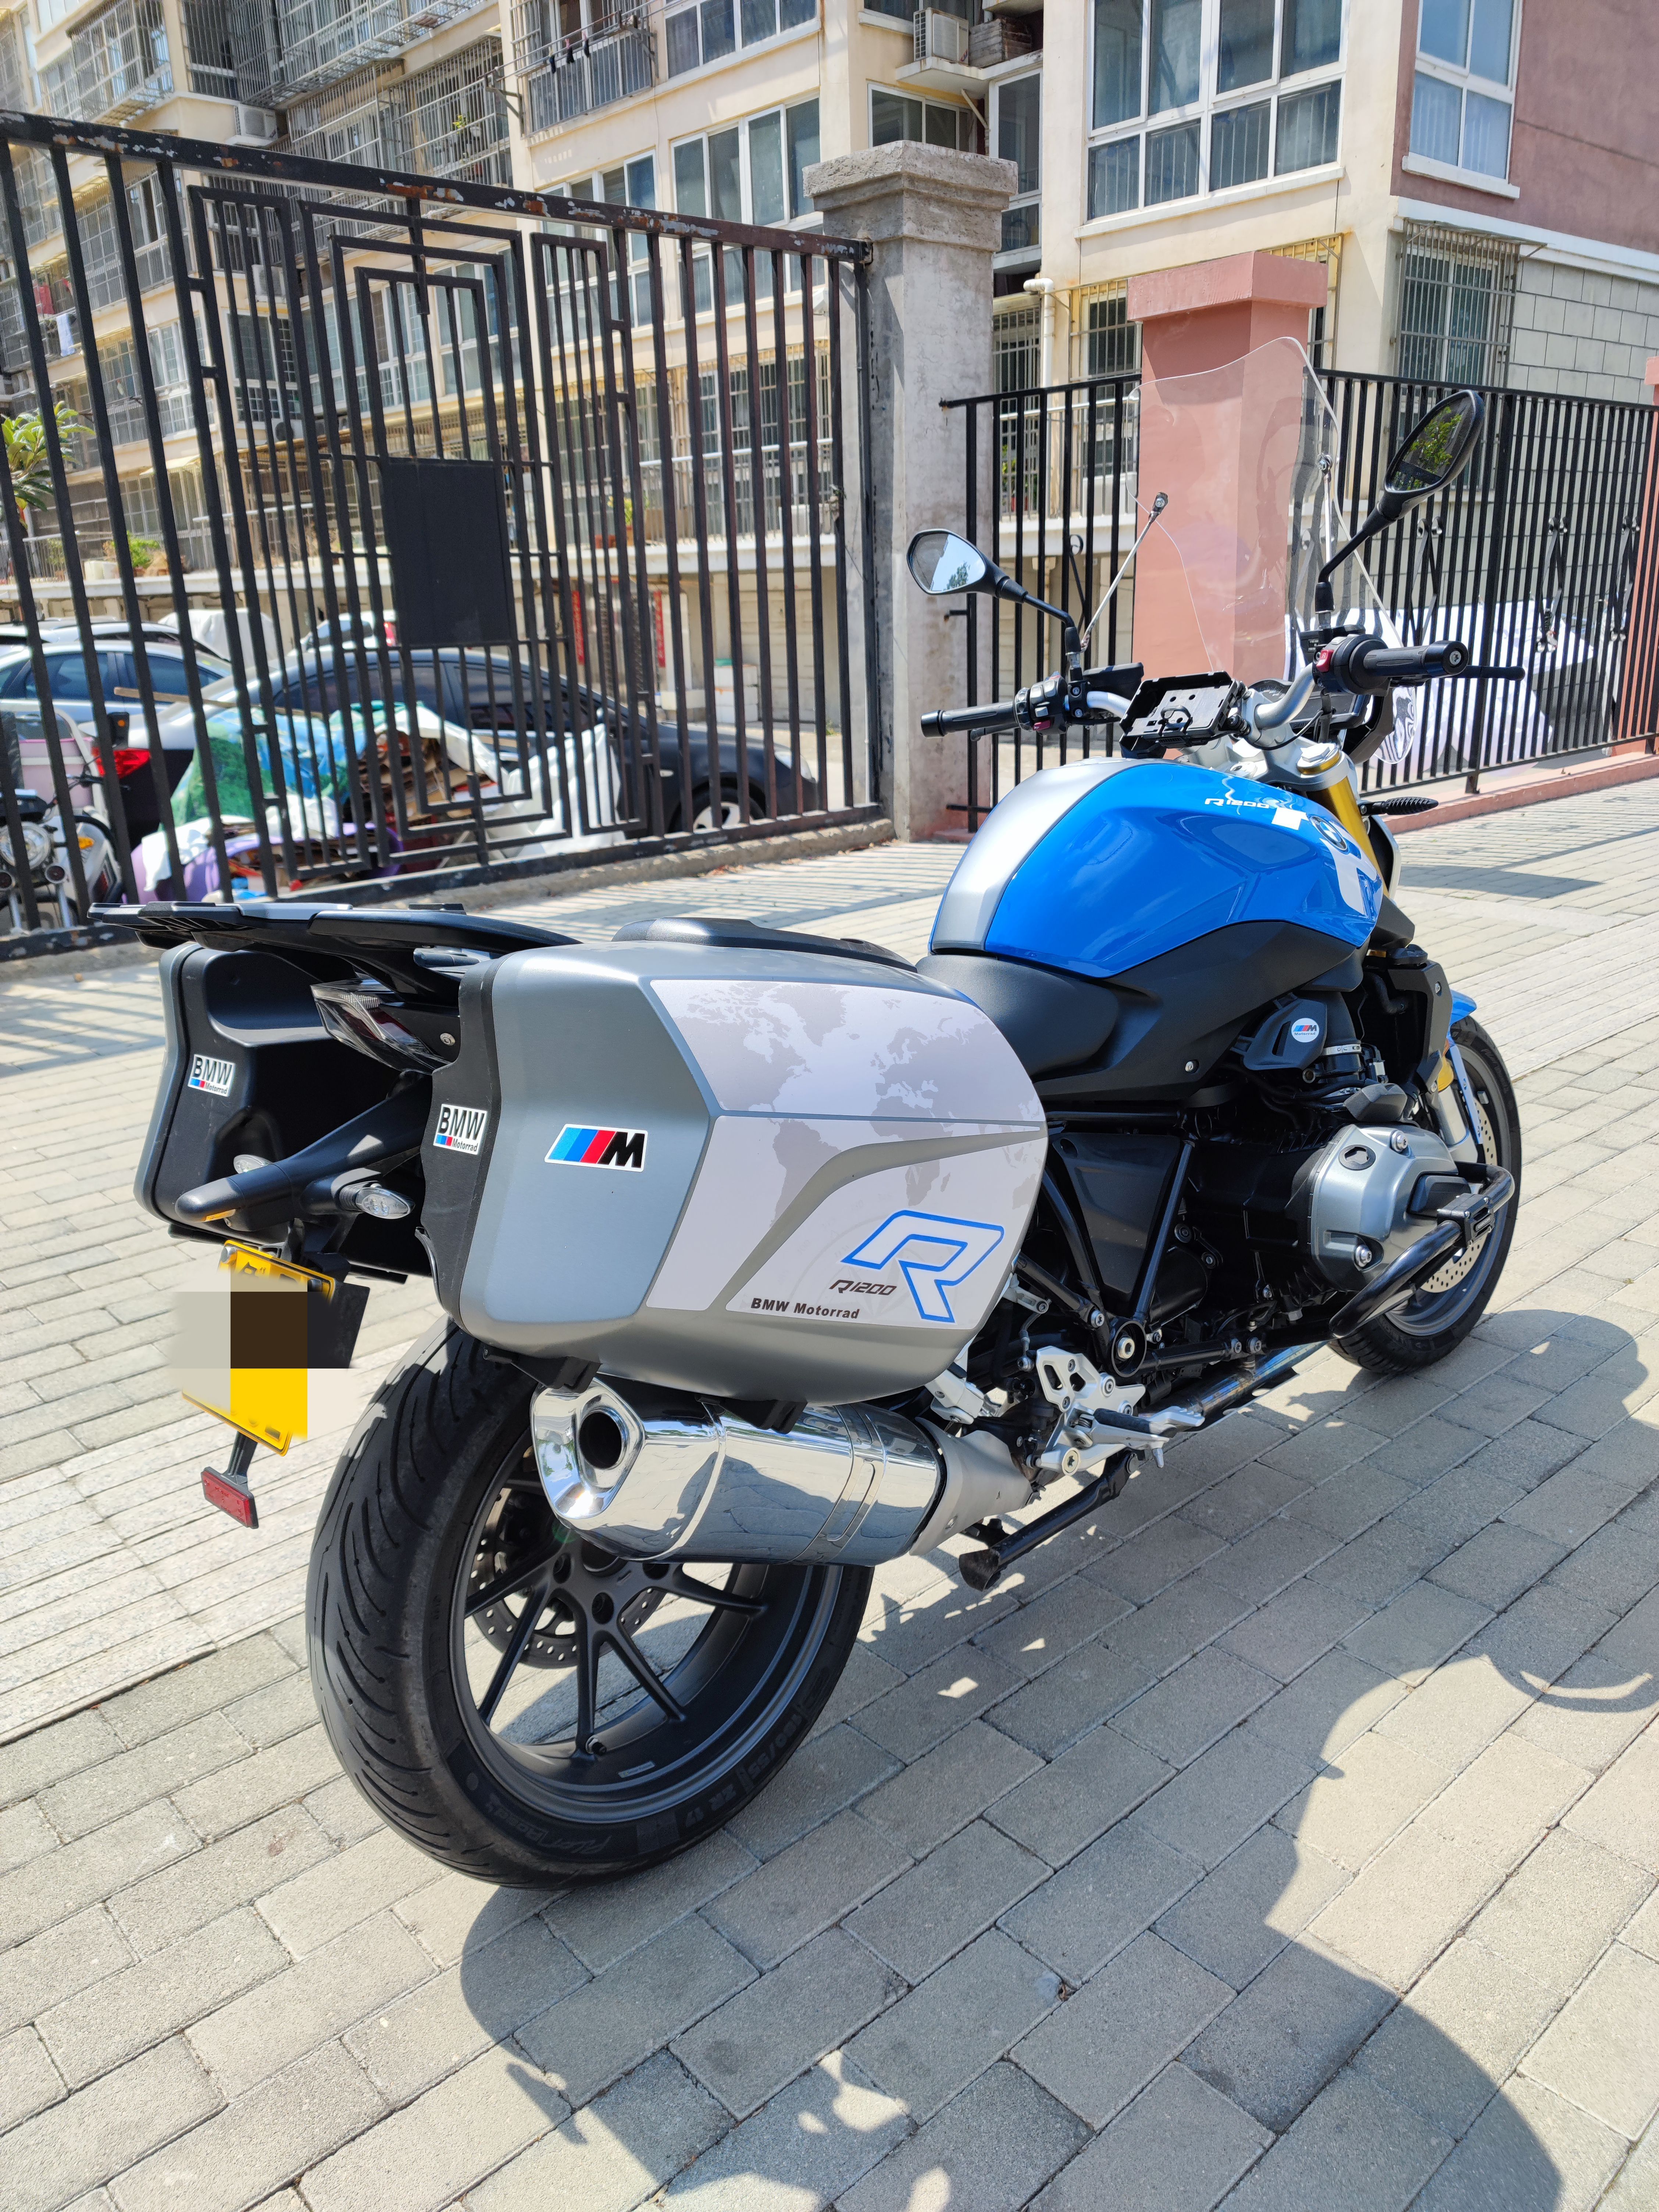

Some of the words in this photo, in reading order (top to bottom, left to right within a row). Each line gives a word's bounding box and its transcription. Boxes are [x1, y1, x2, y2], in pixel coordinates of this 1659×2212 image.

[1205, 798, 1270, 809] R1200
[192, 1056, 233, 1085] BMW
[204, 1082, 228, 1094] Motorrad
[438, 1106, 485, 1141] BMW
[452, 1138, 478, 1152] Motorrad
[597, 1131, 645, 1168] M
[840, 1209, 1005, 1323] R
[828, 1279, 897, 1296] R1200
[750, 1297, 790, 1312] BMW
[793, 1302, 860, 1319] Motorrad
[708, 1783, 737, 1811] ZR
[685, 1806, 705, 1828] 17
